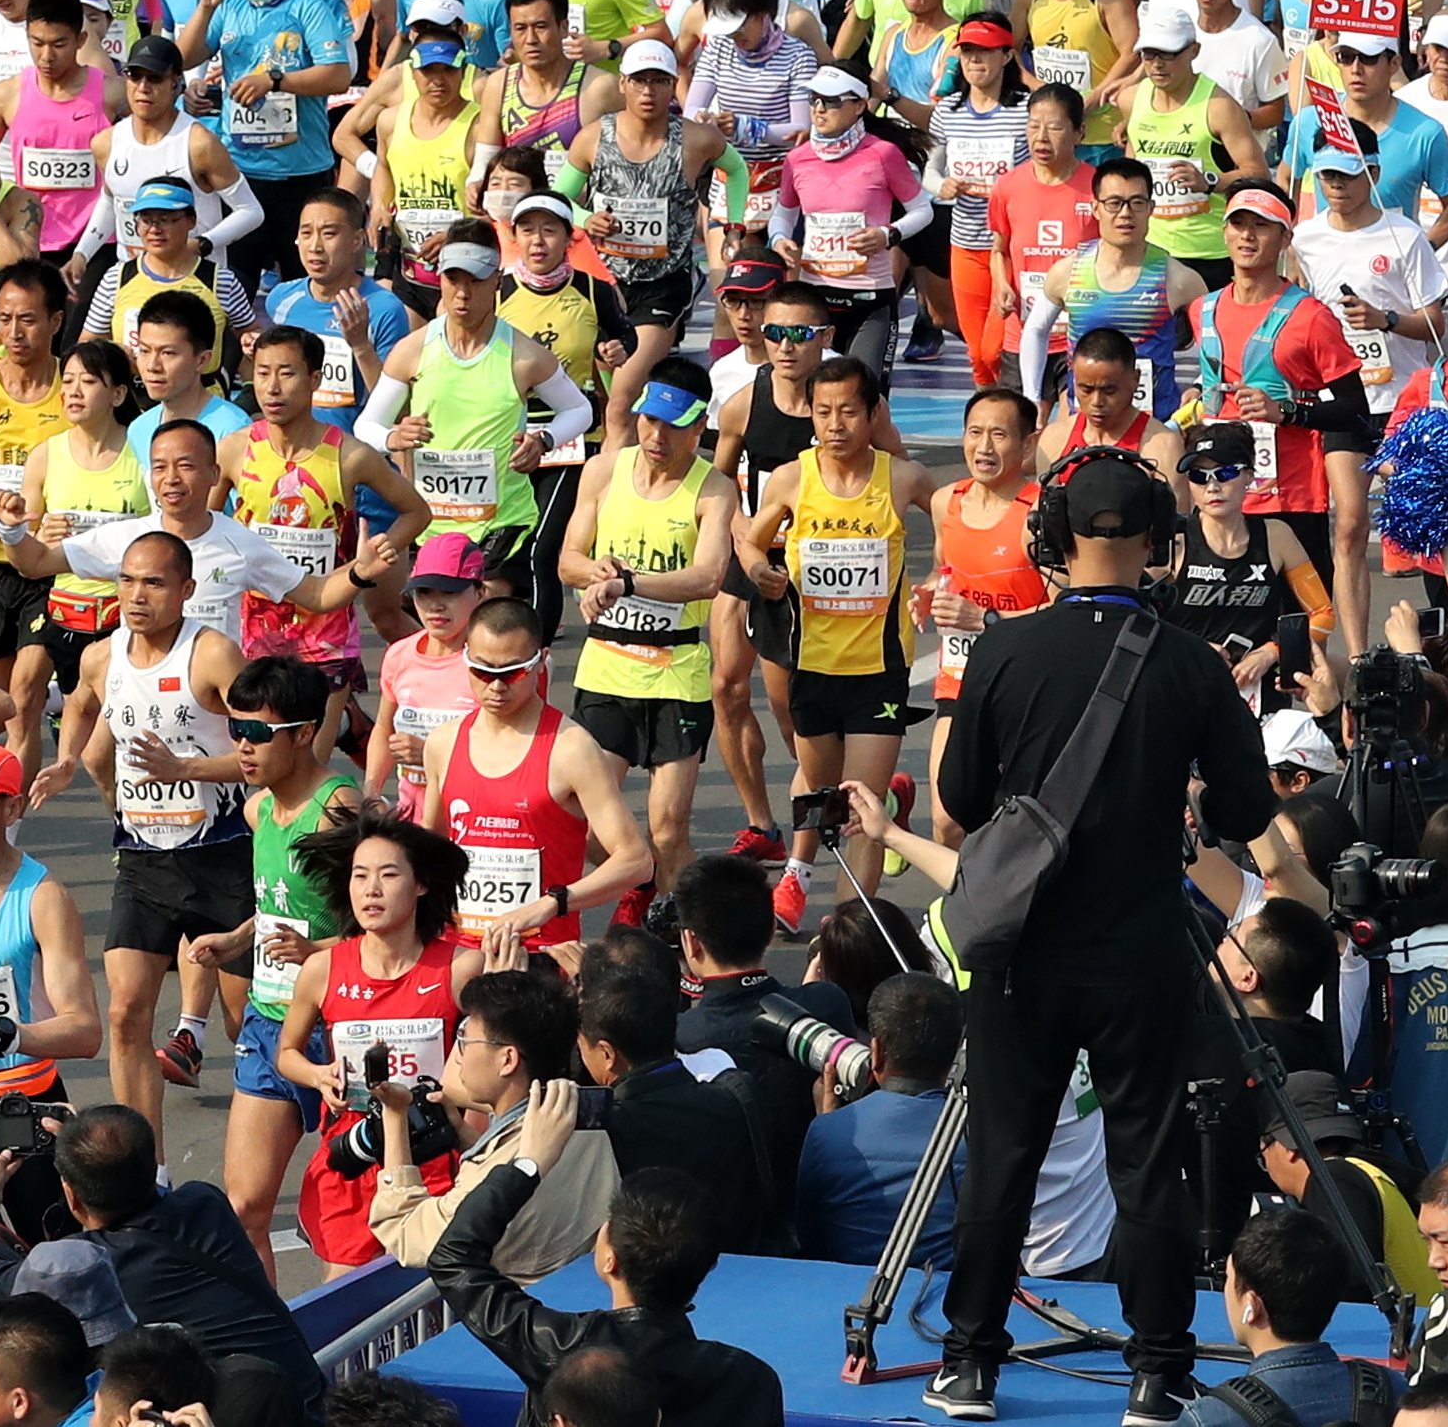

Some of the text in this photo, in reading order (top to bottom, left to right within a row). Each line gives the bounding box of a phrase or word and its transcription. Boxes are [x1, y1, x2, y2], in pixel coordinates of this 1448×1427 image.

[1037, 67, 1084, 85] S0007
[1317, 104, 1350, 142] 3:15
[28, 160, 91, 179] S0323
[954, 158, 1007, 177] S2128
[615, 220, 662, 237] 0370
[422, 475, 486, 495] S0177
[807, 565, 881, 587] S0071
[602, 608, 671, 631] S0182
[122, 781, 195, 804] S0070
[458, 881, 531, 905] S0257
[336, 983, 375, 1000] 内蒙古
[373, 1020, 428, 1036] 君乐宝集团
